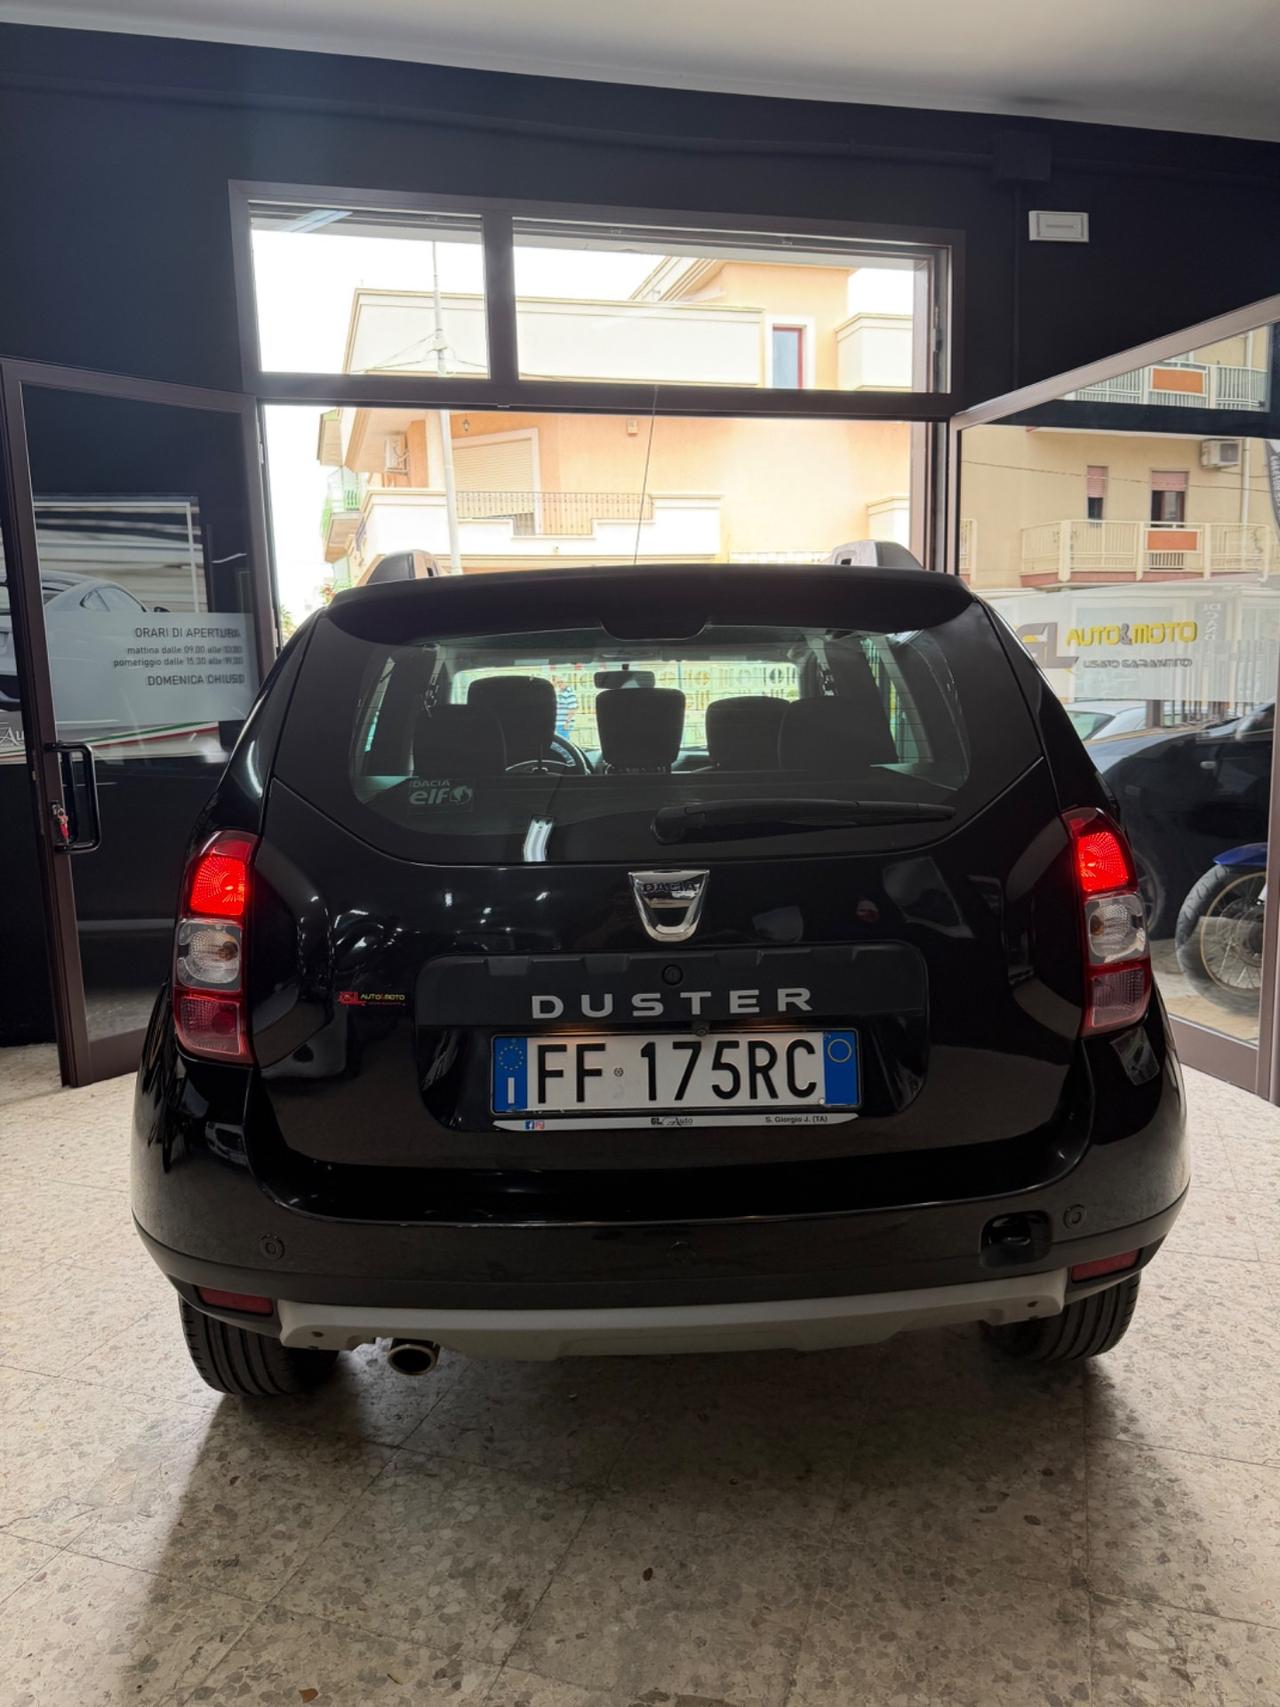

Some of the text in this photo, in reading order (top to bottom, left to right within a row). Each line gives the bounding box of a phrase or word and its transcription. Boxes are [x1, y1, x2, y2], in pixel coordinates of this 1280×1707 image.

[134, 627, 241, 639] ORARI DI APERTURA
[1065, 621, 1198, 646] AUTO&MOTO
[127, 646, 160, 655] mattina
[162, 646, 182, 654] dalle
[207, 646, 222, 654] alle
[113, 658, 162, 668] pomeriggio
[164, 657, 184, 666] dalle
[208, 657, 222, 665] alle
[147, 674, 246, 686] DOMENICA CHIUSO
[409, 788, 450, 805] elf
[531, 987, 814, 1019] DUSTER
[507, 1038, 818, 1104] I FF 175RC
[774, 1116, 801, 1125] Giorgio
[812, 1115, 829, 1124] (TA)
